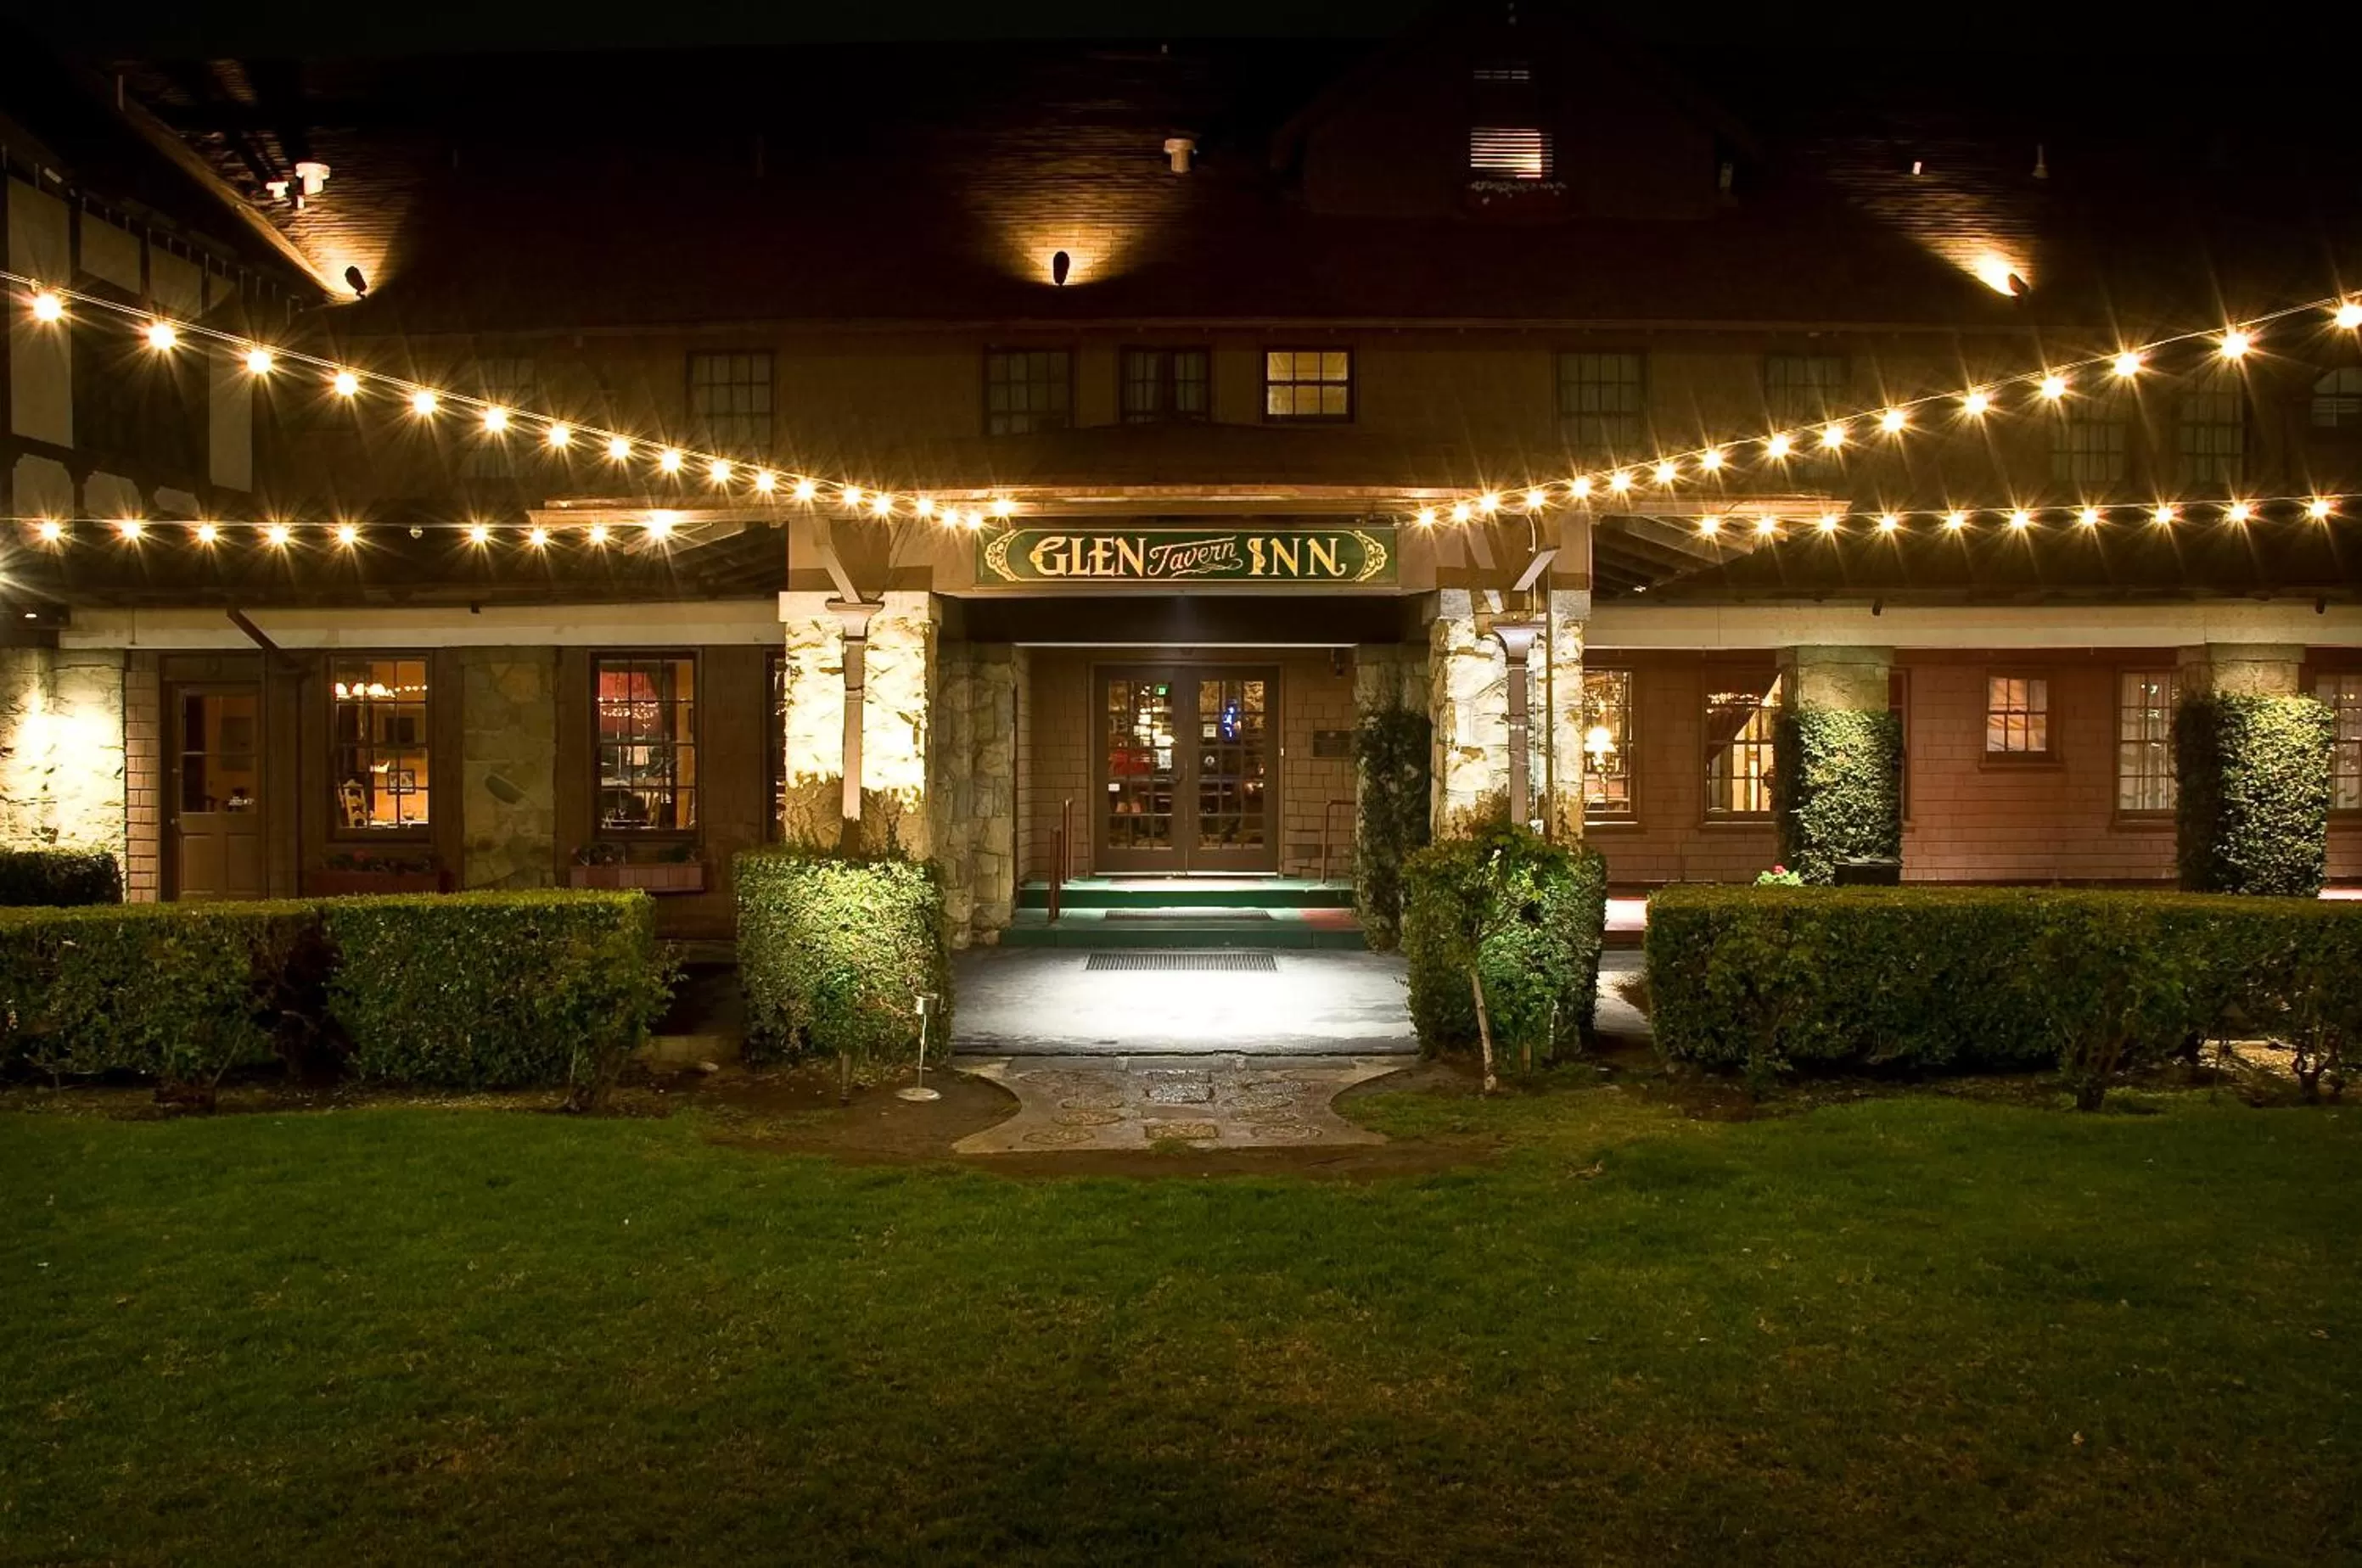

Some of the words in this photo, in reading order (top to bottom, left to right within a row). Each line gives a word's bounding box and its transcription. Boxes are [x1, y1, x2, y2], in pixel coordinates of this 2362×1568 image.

[1030, 535, 1146, 577] GLEN
[1147, 535, 1243, 578] Tavern
[1247, 536, 1347, 577] INN
